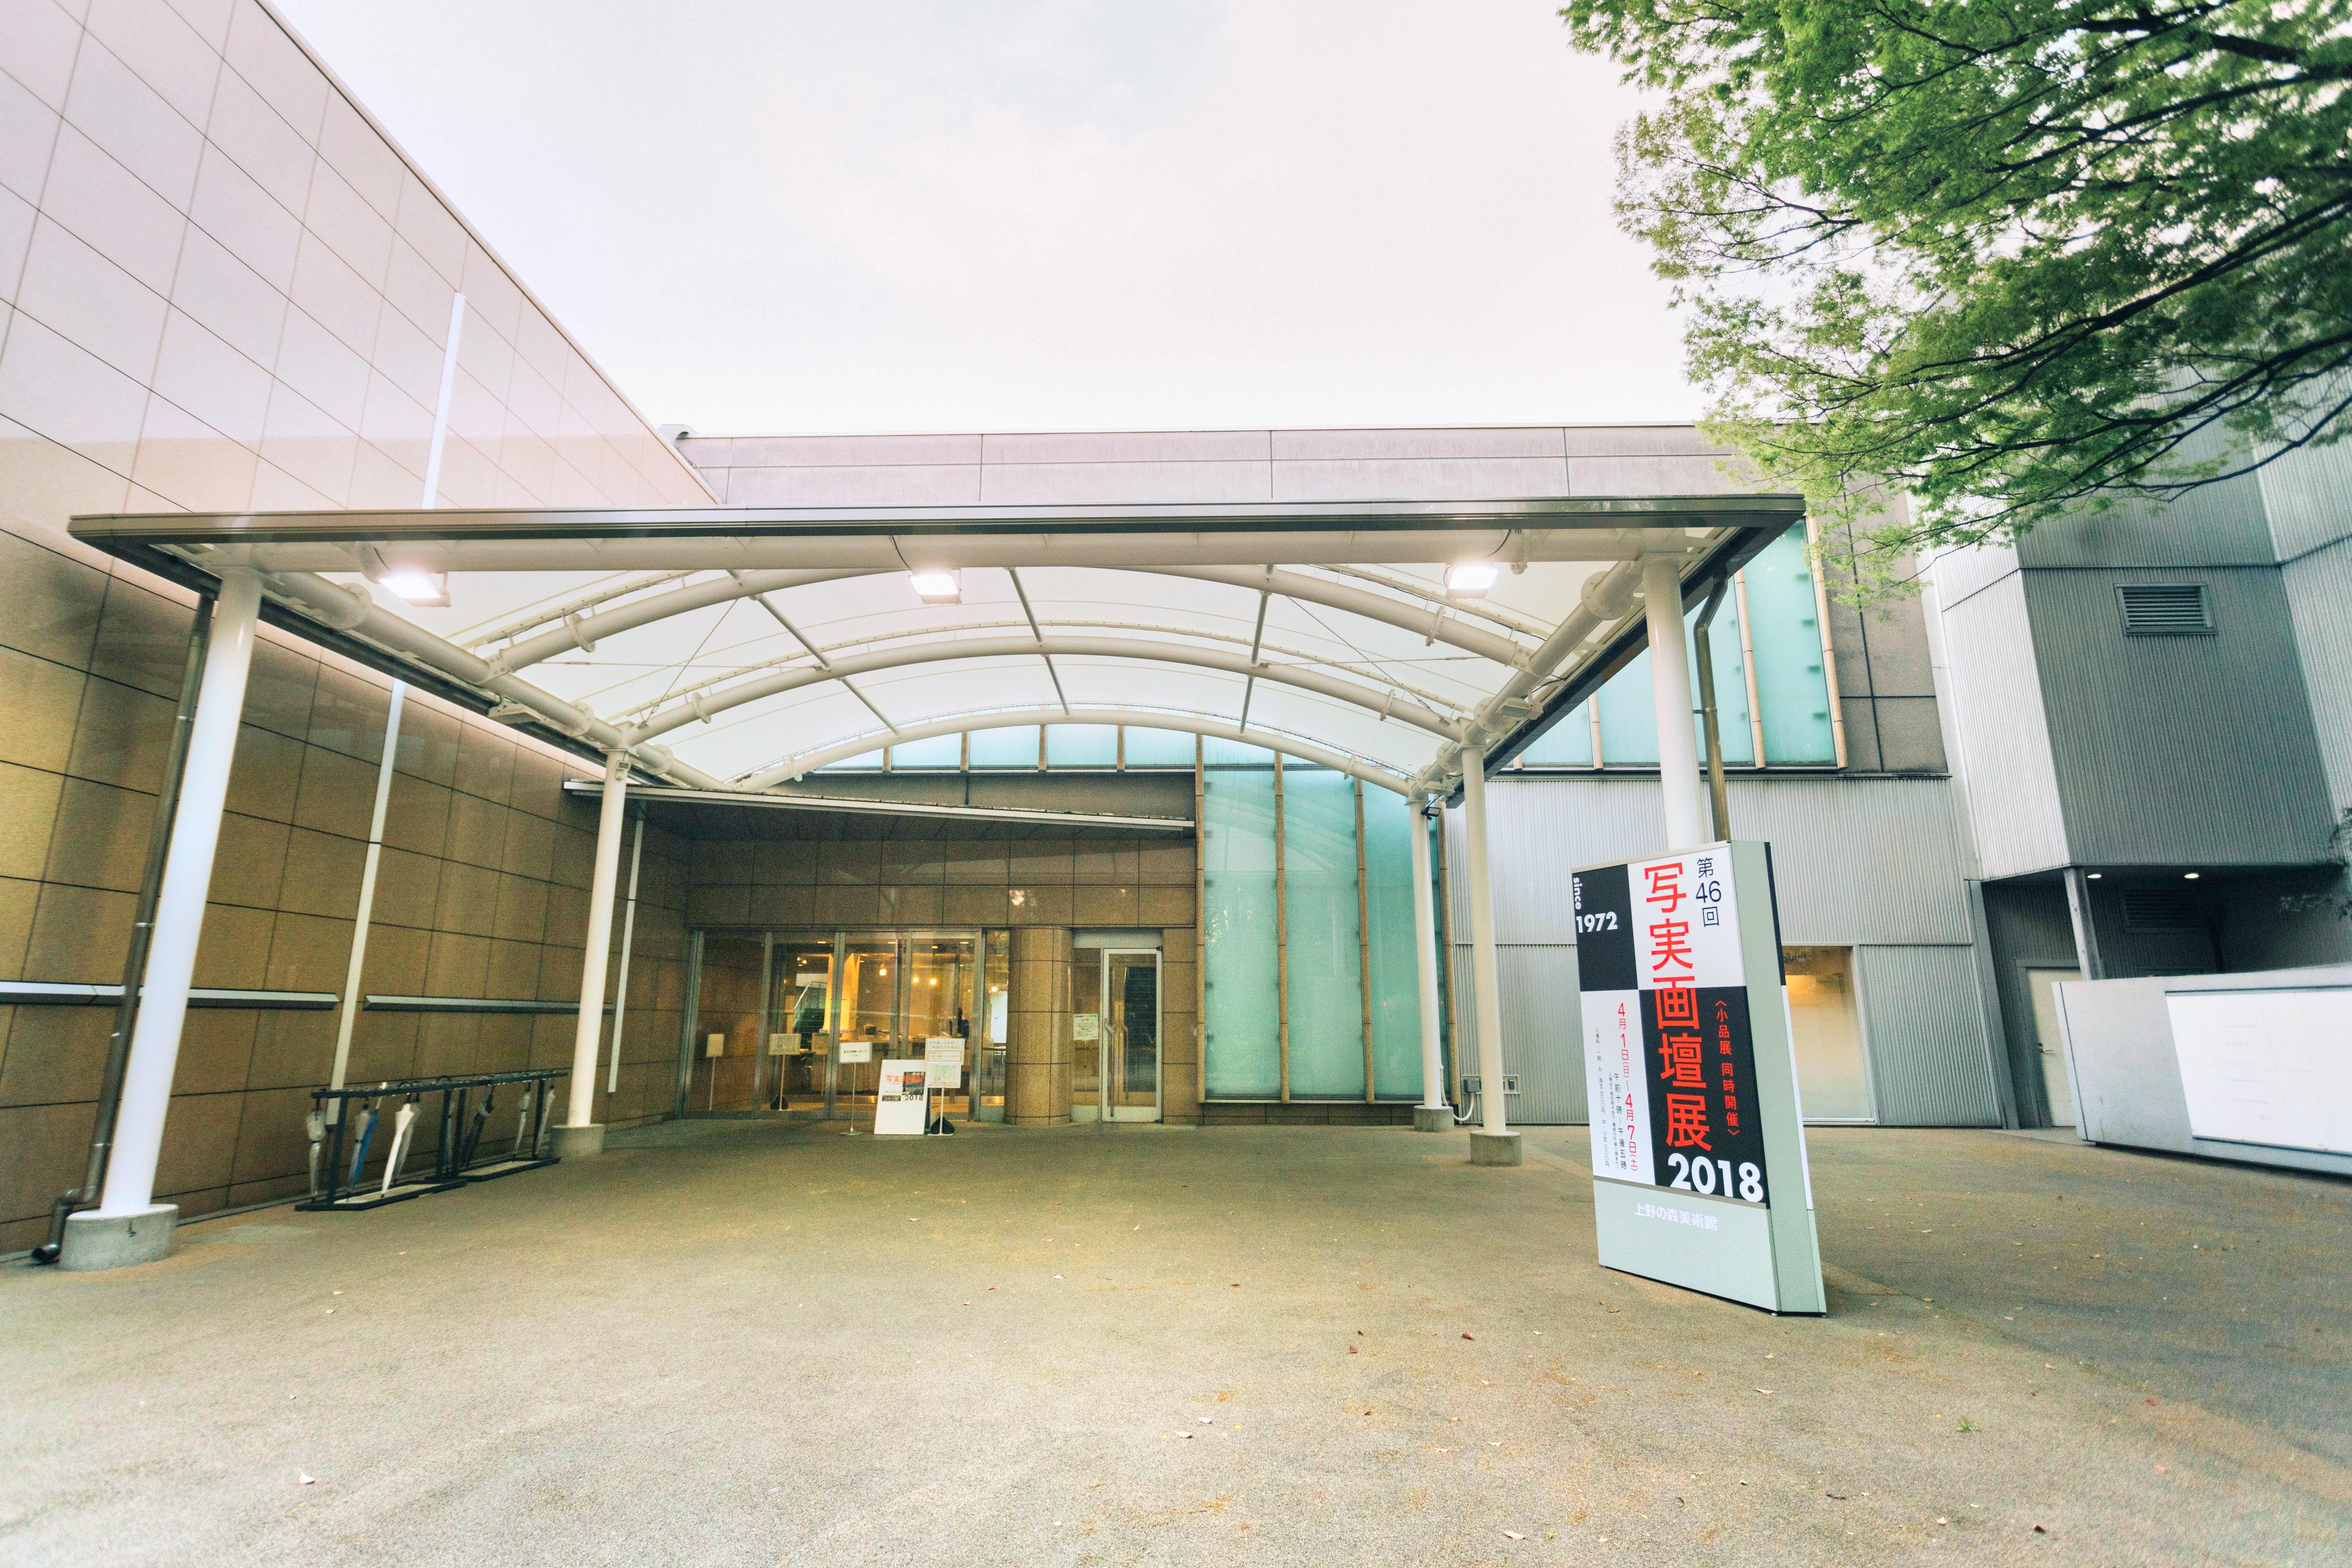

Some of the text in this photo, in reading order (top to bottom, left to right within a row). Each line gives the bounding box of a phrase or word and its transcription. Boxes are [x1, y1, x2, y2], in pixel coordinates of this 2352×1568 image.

[1573, 877, 1583, 910] since
[1696, 857, 1721, 927] 第46回
[1576, 911, 1618, 933] 1972
[1644, 862, 1712, 1151] 写実画壇展
[1668, 1152, 1764, 1203] 2018
[1634, 1203, 1718, 1230] 上野の森美術館
